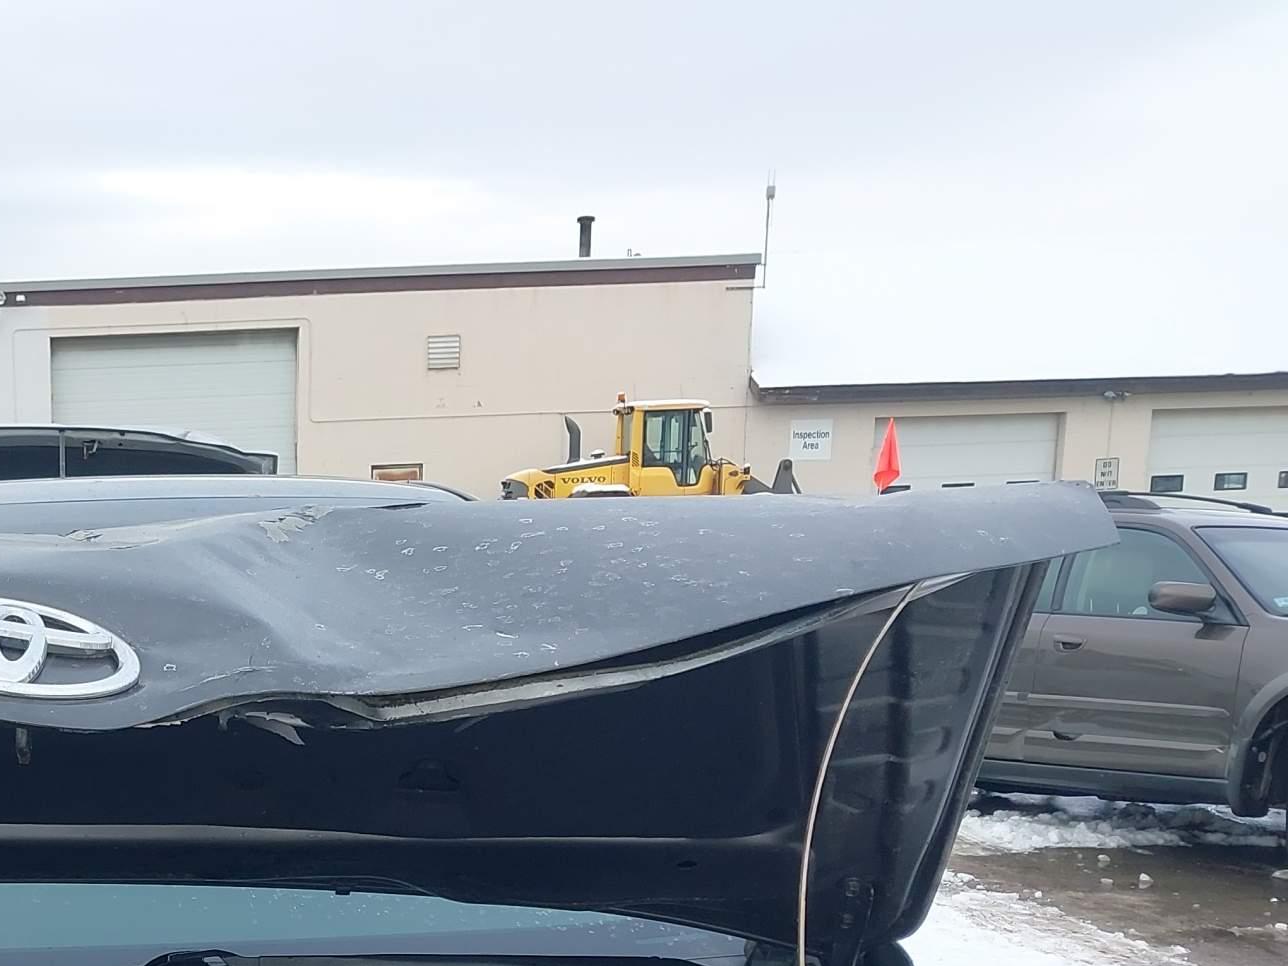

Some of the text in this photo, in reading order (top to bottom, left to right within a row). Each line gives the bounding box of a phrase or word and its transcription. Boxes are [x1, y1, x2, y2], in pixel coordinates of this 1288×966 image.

[792, 430, 830, 440] Inspection
[802, 441, 819, 450] Area
[561, 475, 606, 484] VOLVO
